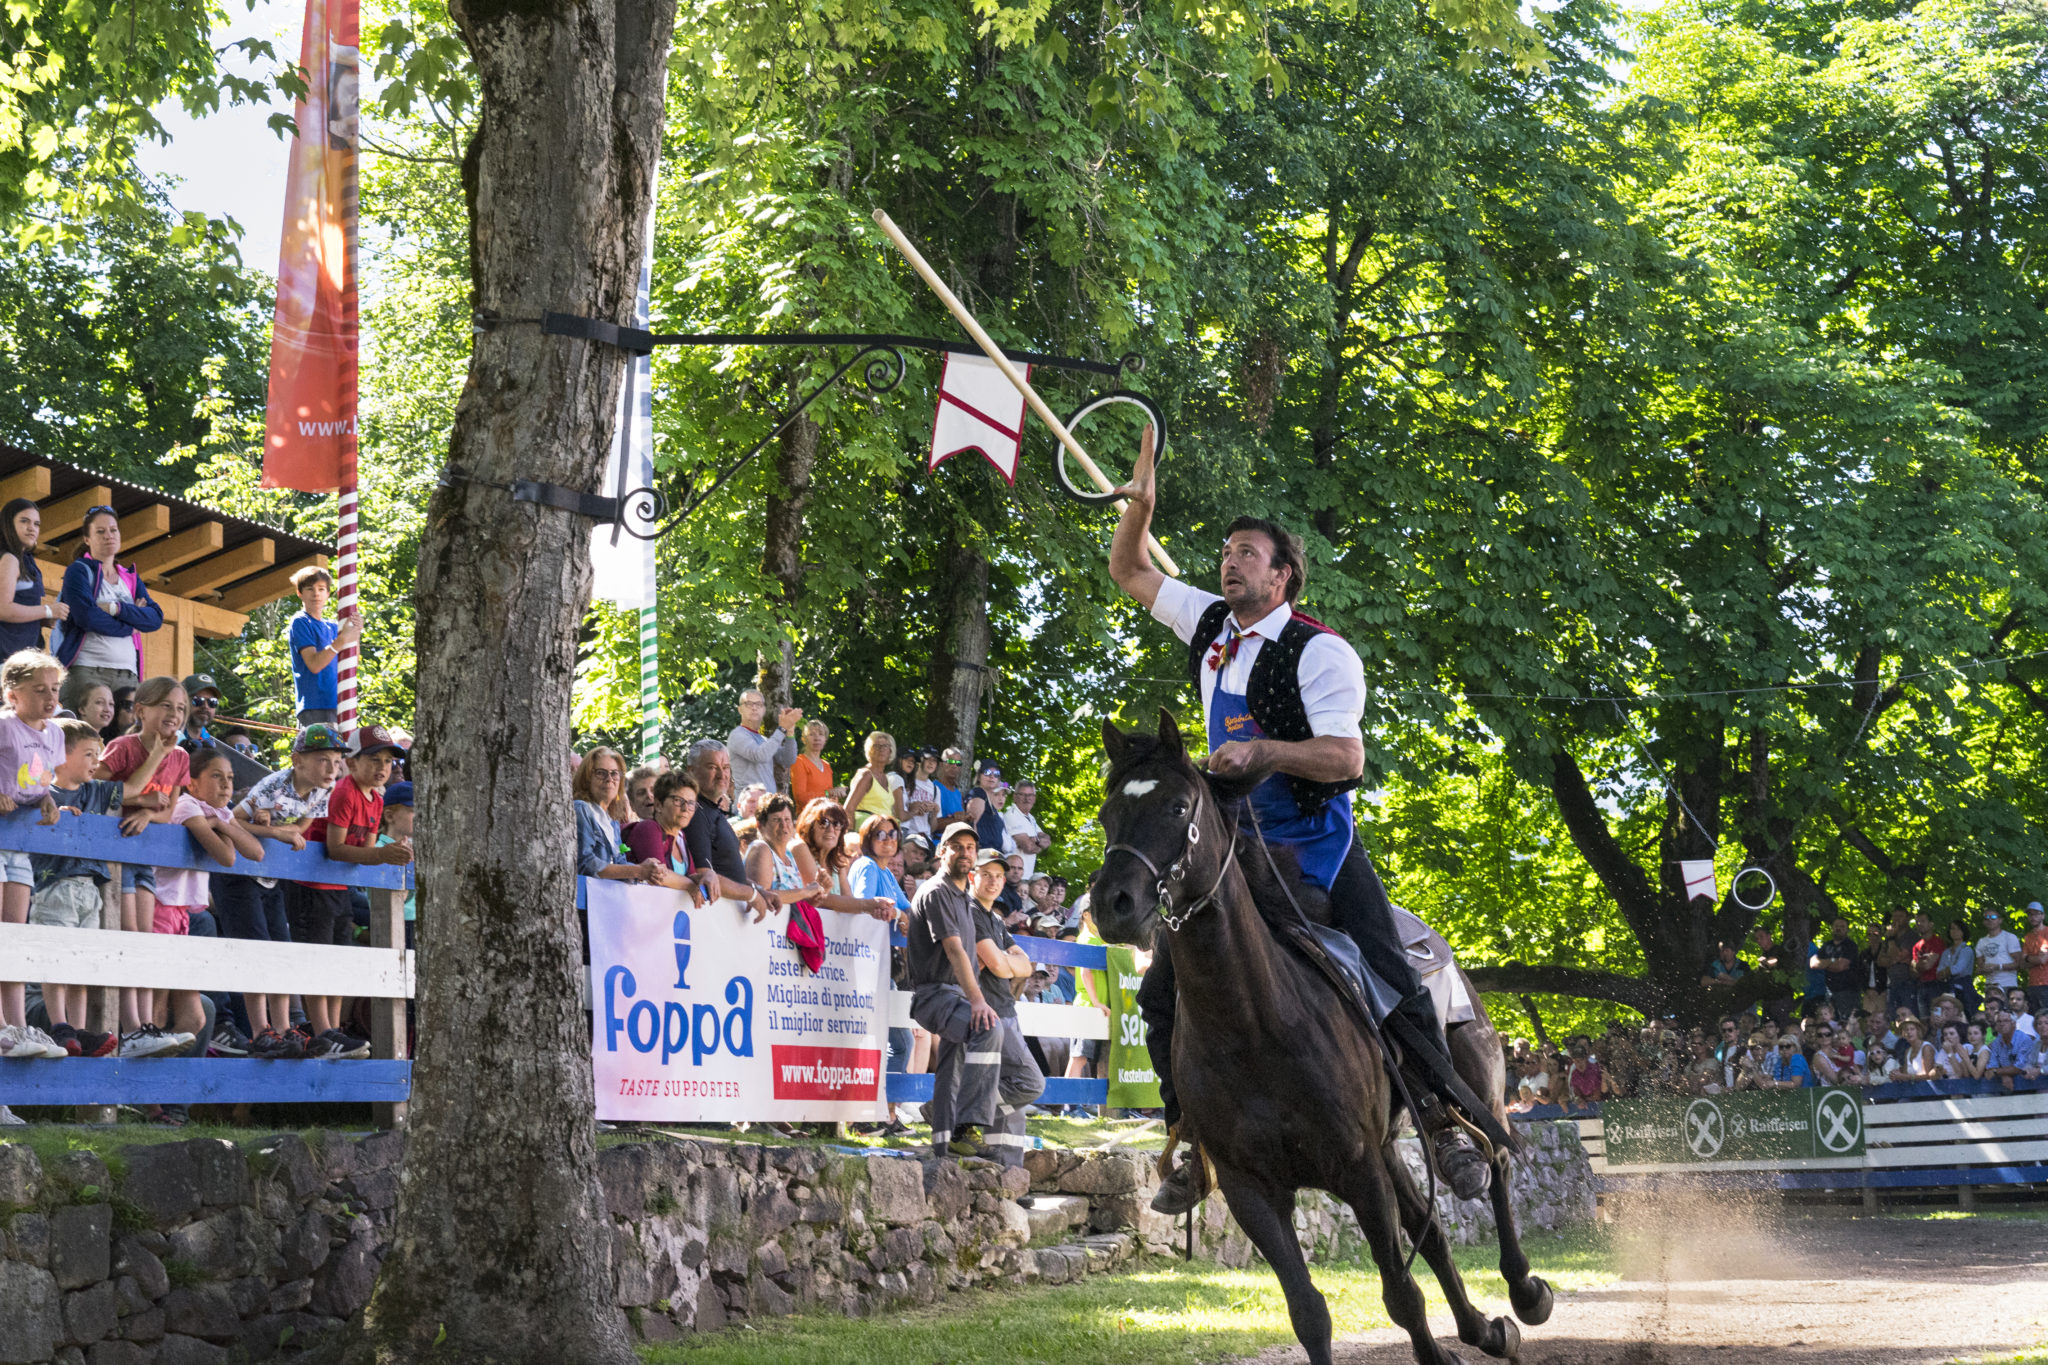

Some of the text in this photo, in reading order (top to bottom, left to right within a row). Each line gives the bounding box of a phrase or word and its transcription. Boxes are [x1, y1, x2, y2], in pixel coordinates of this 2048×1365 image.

[824, 937, 876, 962] Produkte,
[769, 955, 805, 977] bester
[767, 984, 819, 1008] Migliaia
[821, 986, 832, 1006] di
[604, 965, 754, 1067] foppa
[769, 1010, 778, 1030] il
[781, 1012, 824, 1036] miglior
[781, 1059, 875, 1090] www.foppa.com
[619, 1078, 741, 1098] TASTE SUPPORTER
[1750, 1117, 1809, 1133] Raiffeisen
